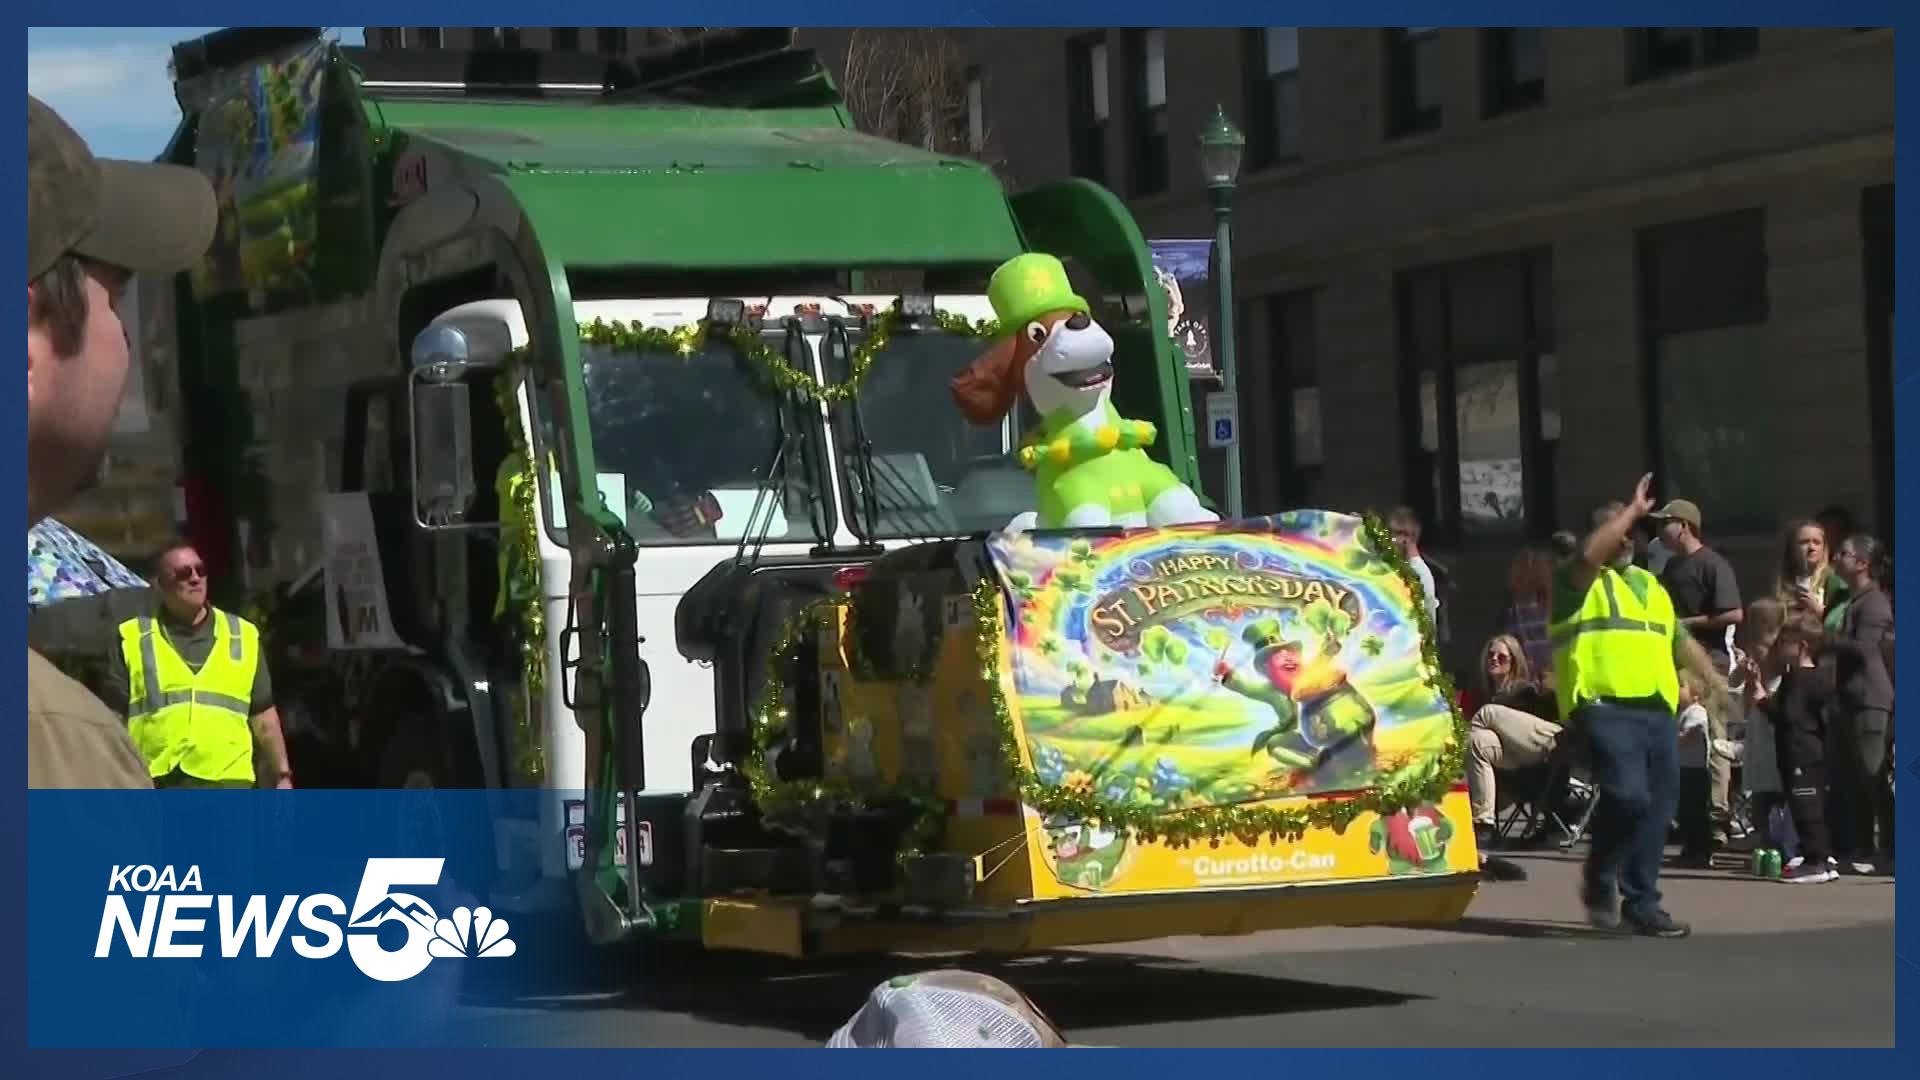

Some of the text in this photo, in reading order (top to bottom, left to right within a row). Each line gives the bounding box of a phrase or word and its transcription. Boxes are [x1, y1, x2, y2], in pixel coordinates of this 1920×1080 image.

[1160, 553, 1231, 576] HAPPY
[1091, 597, 1142, 637] ST.
[1279, 577, 1349, 609] DAY
[1193, 850, 1336, 877] Curotto-Can
